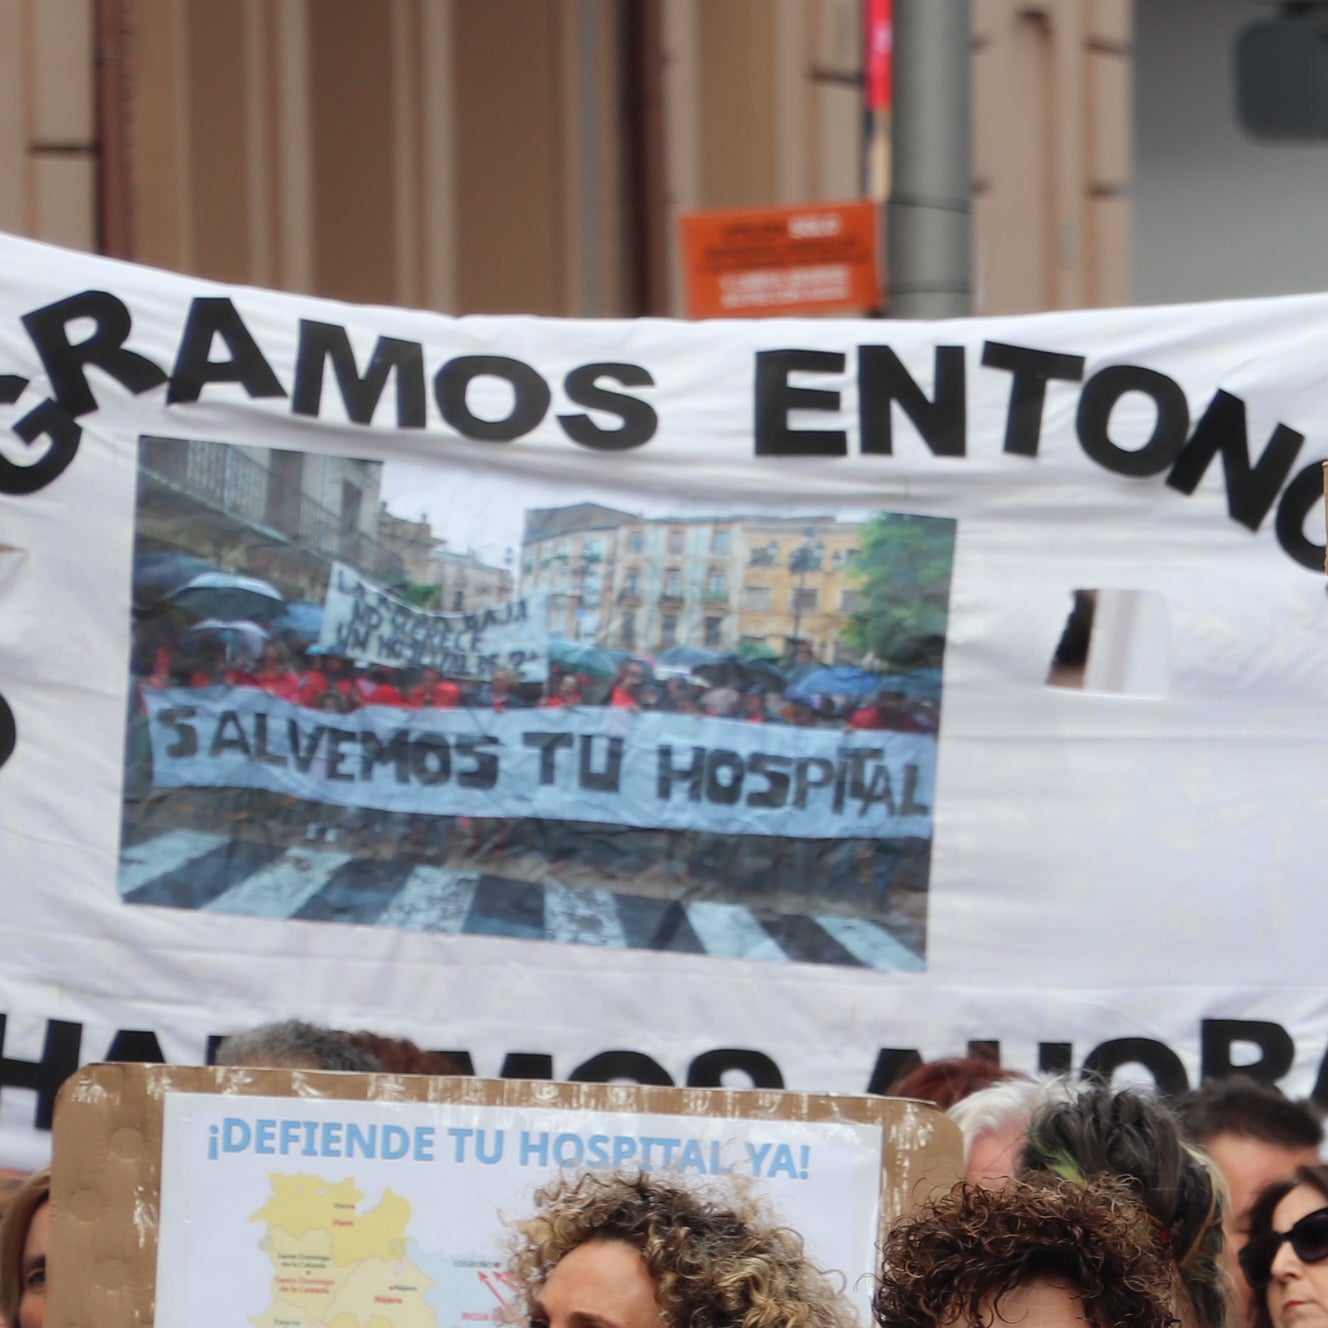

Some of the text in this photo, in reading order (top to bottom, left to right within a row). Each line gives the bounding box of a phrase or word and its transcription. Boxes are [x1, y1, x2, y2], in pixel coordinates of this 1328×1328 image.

[157, 705, 929, 819] SALVEMOS TU HOSPITAL
[207, 1117, 811, 1180] ¡DEFIENDE TU HOSPITAL YA!
